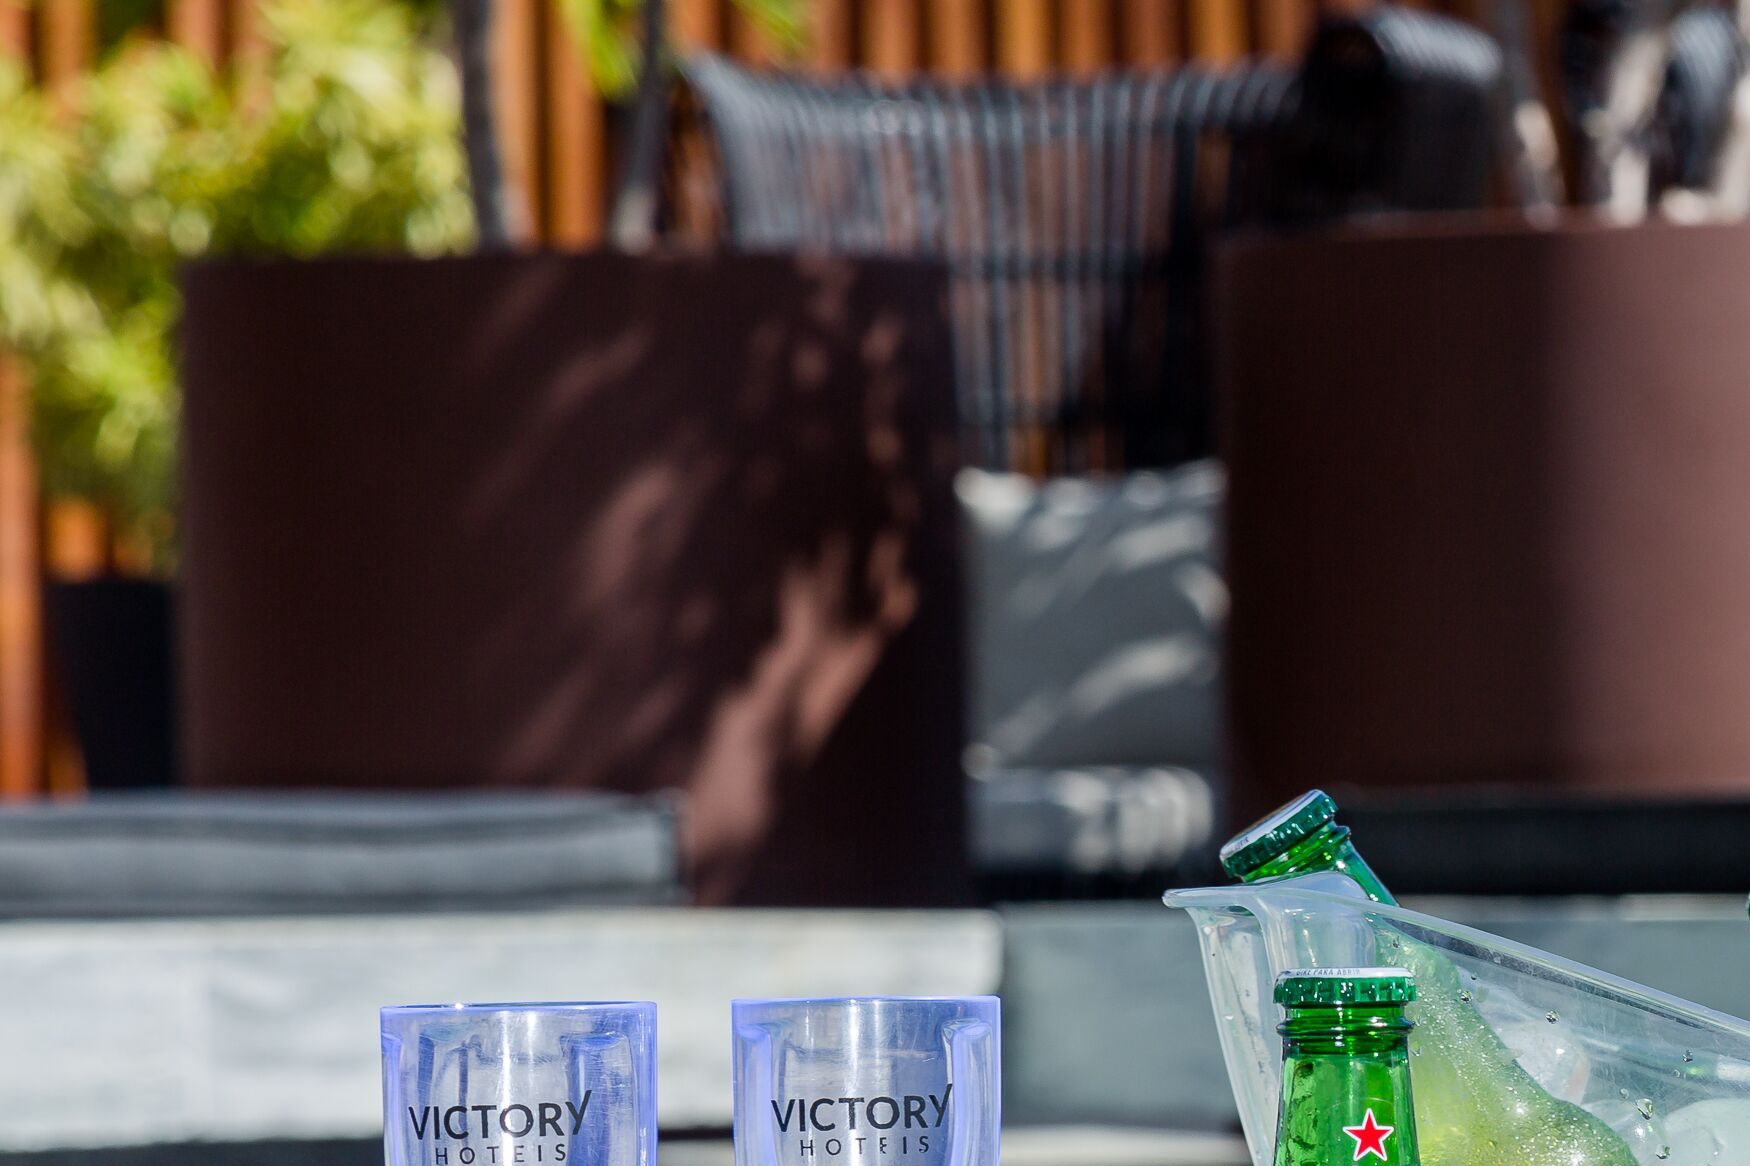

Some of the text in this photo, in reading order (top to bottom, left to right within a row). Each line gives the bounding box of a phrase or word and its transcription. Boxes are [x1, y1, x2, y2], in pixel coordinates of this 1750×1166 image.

[1313, 968, 1334, 976] PARA
[408, 1089, 593, 1141] VICTORY
[771, 1083, 953, 1133] VICTORY
